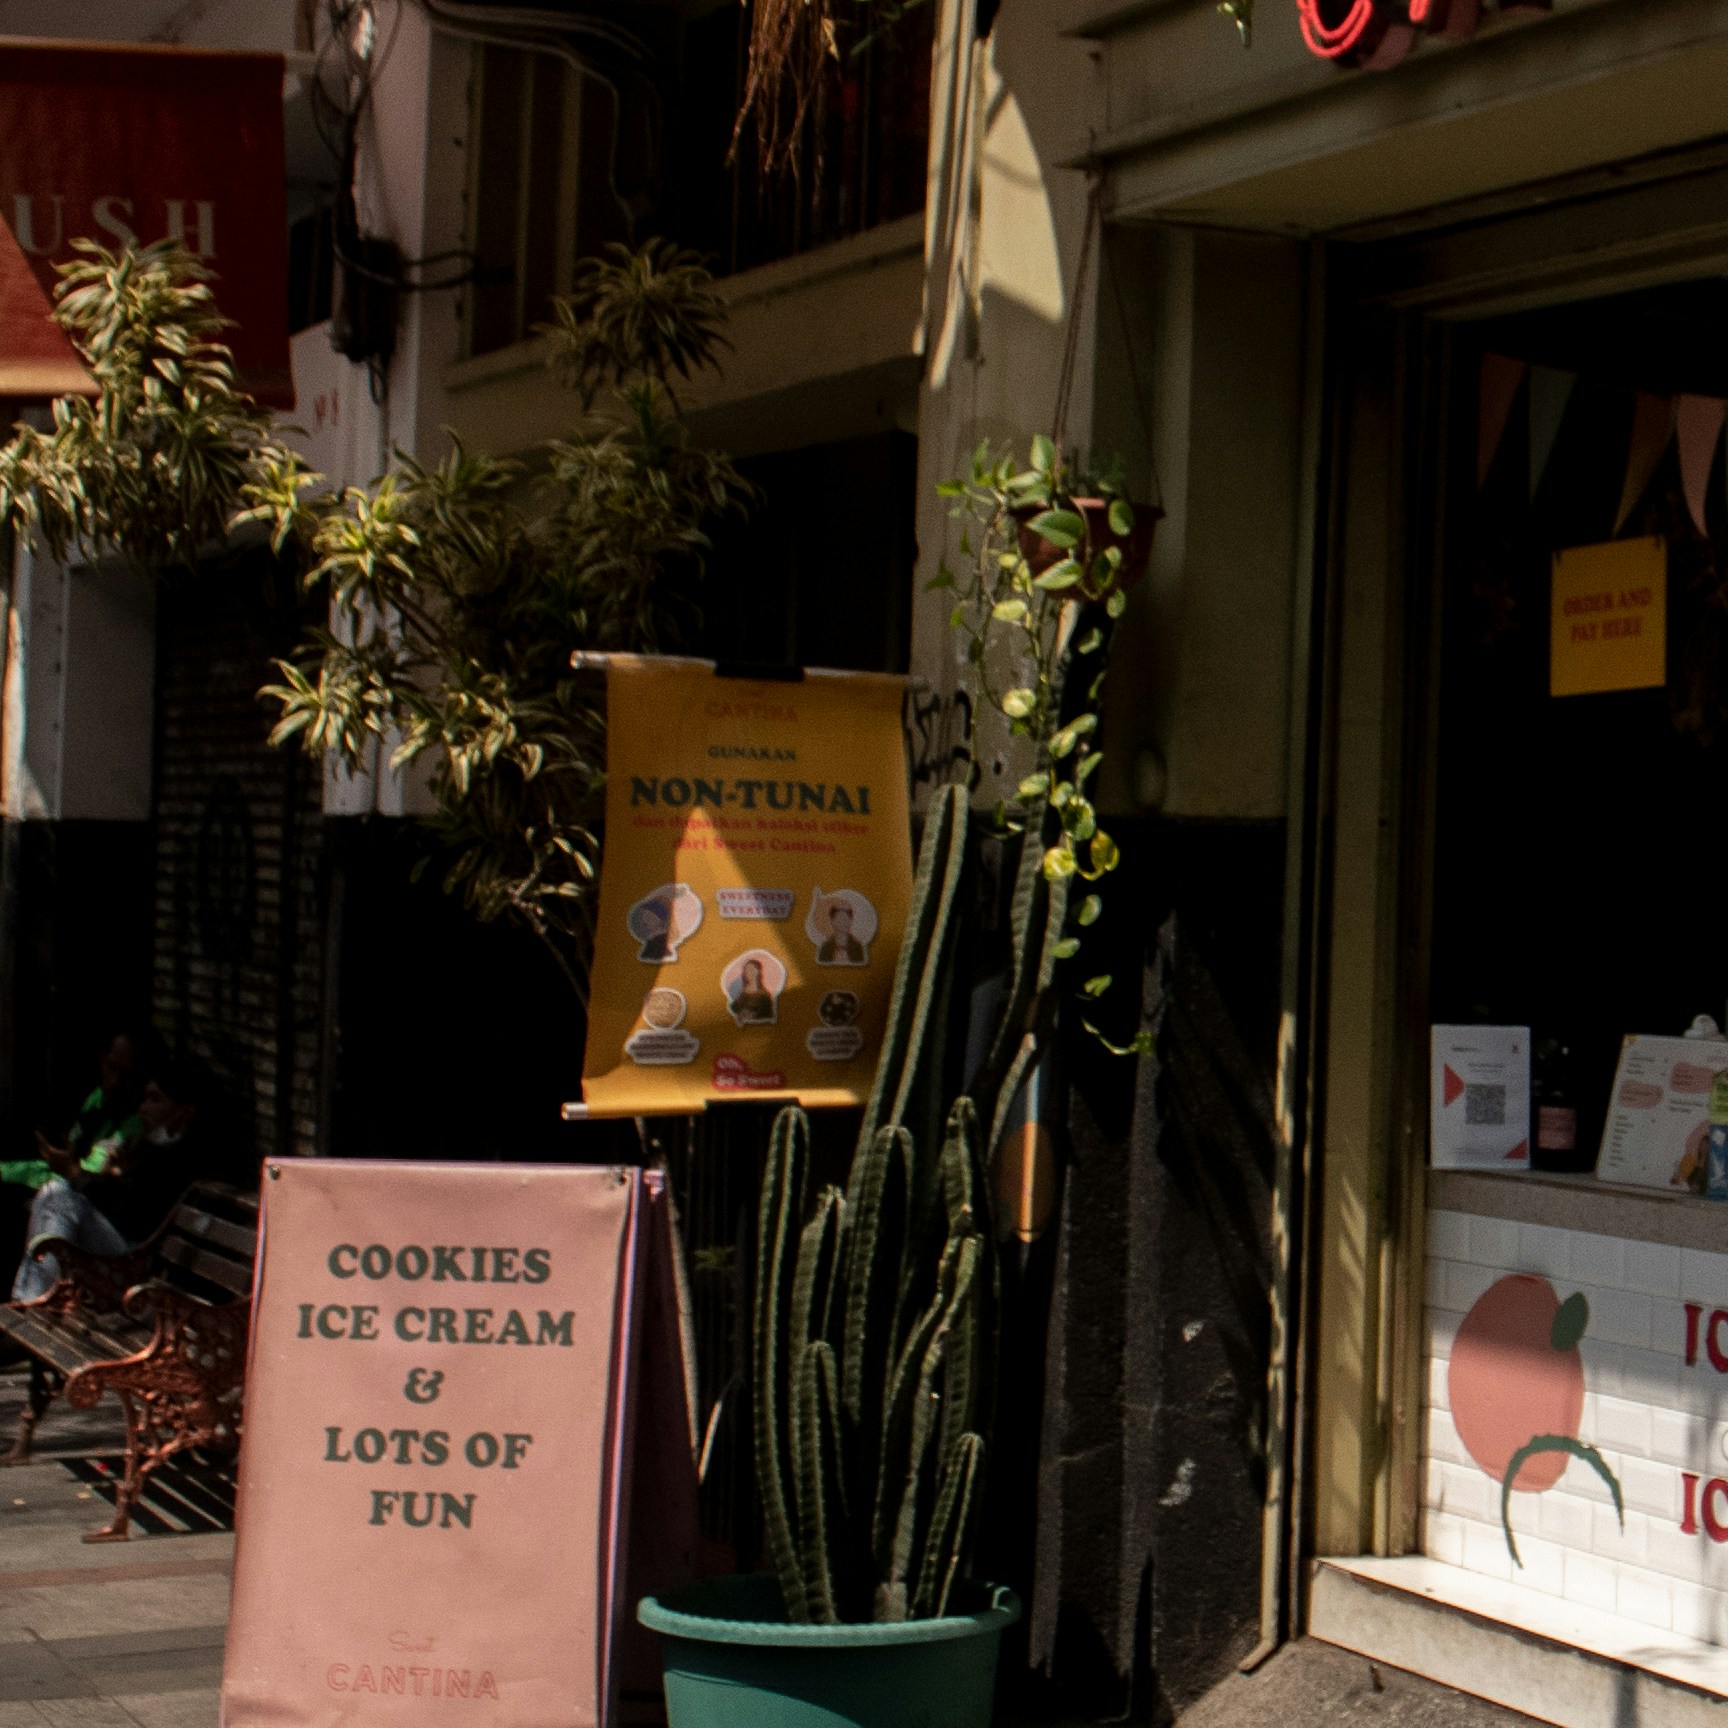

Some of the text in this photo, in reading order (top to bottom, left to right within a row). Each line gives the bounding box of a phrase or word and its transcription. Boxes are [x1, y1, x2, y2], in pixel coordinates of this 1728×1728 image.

[708, 745, 796, 761] GUNAKAN
[630, 776, 872, 815] NON-TUNAI
[769, 838, 836, 853] Cantina
[327, 1244, 552, 1285] COOKIES
[297, 1304, 576, 1347] ICE CREAM
[404, 1368, 444, 1404] &
[323, 1426, 533, 1470] LOTS OF
[368, 1491, 477, 1529] FUN
[326, 1662, 499, 1701] CANTINA
